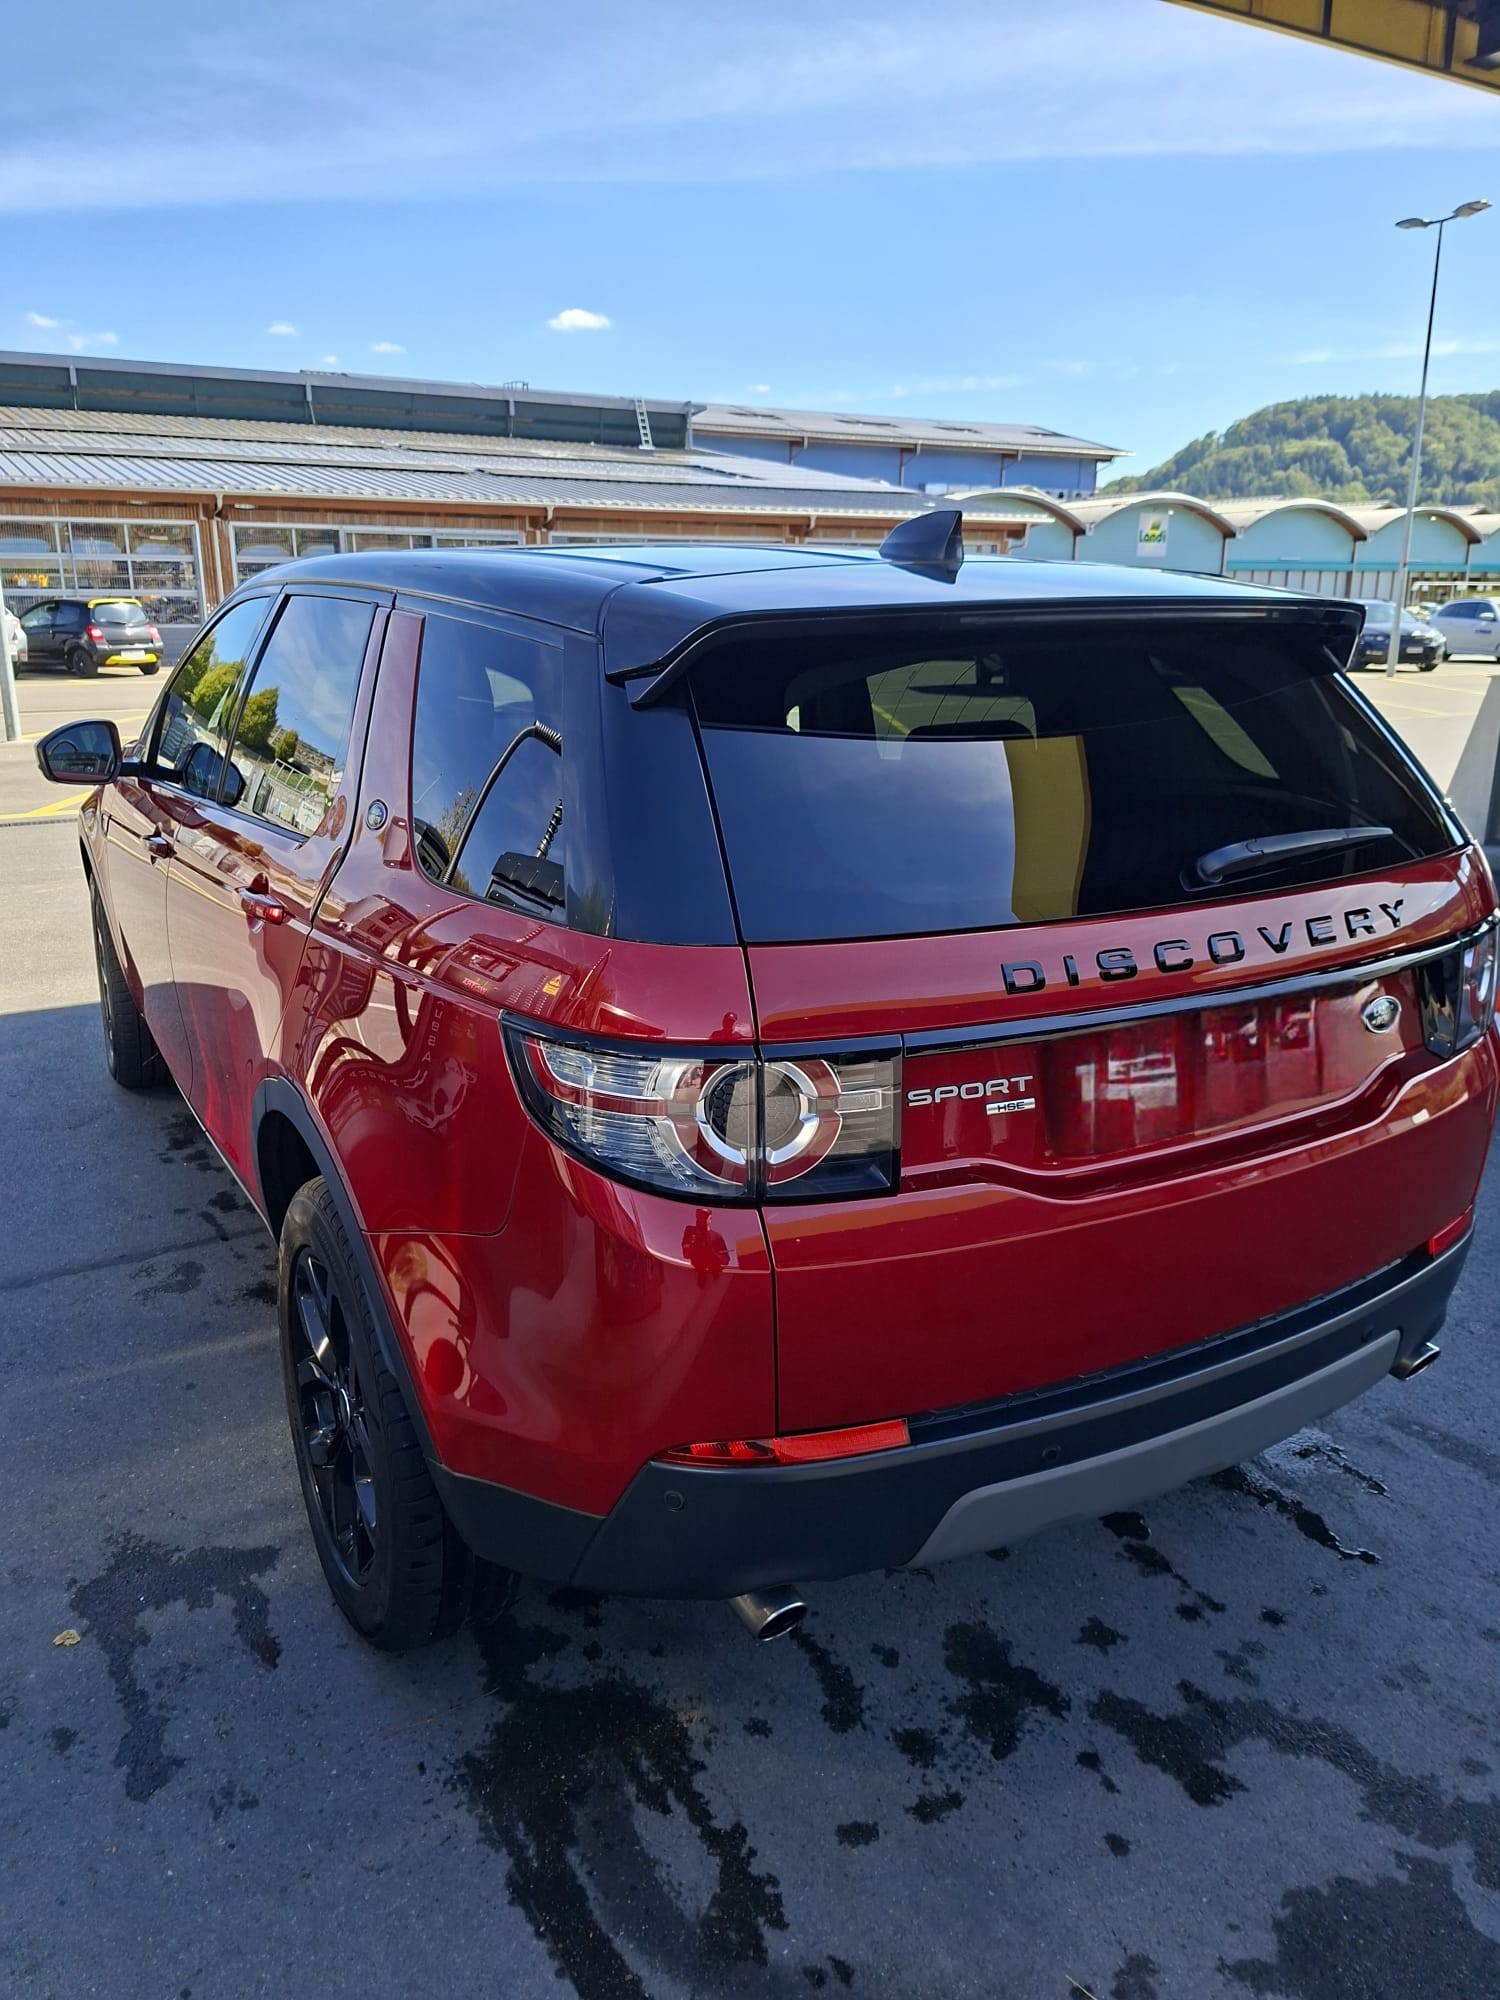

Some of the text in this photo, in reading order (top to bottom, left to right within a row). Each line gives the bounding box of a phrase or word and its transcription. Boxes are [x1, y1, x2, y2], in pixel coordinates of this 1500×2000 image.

[1001, 899, 1404, 995] DISCOVERY
[907, 1075, 1033, 1107] SPORT
[997, 1101, 1025, 1112] HSE
